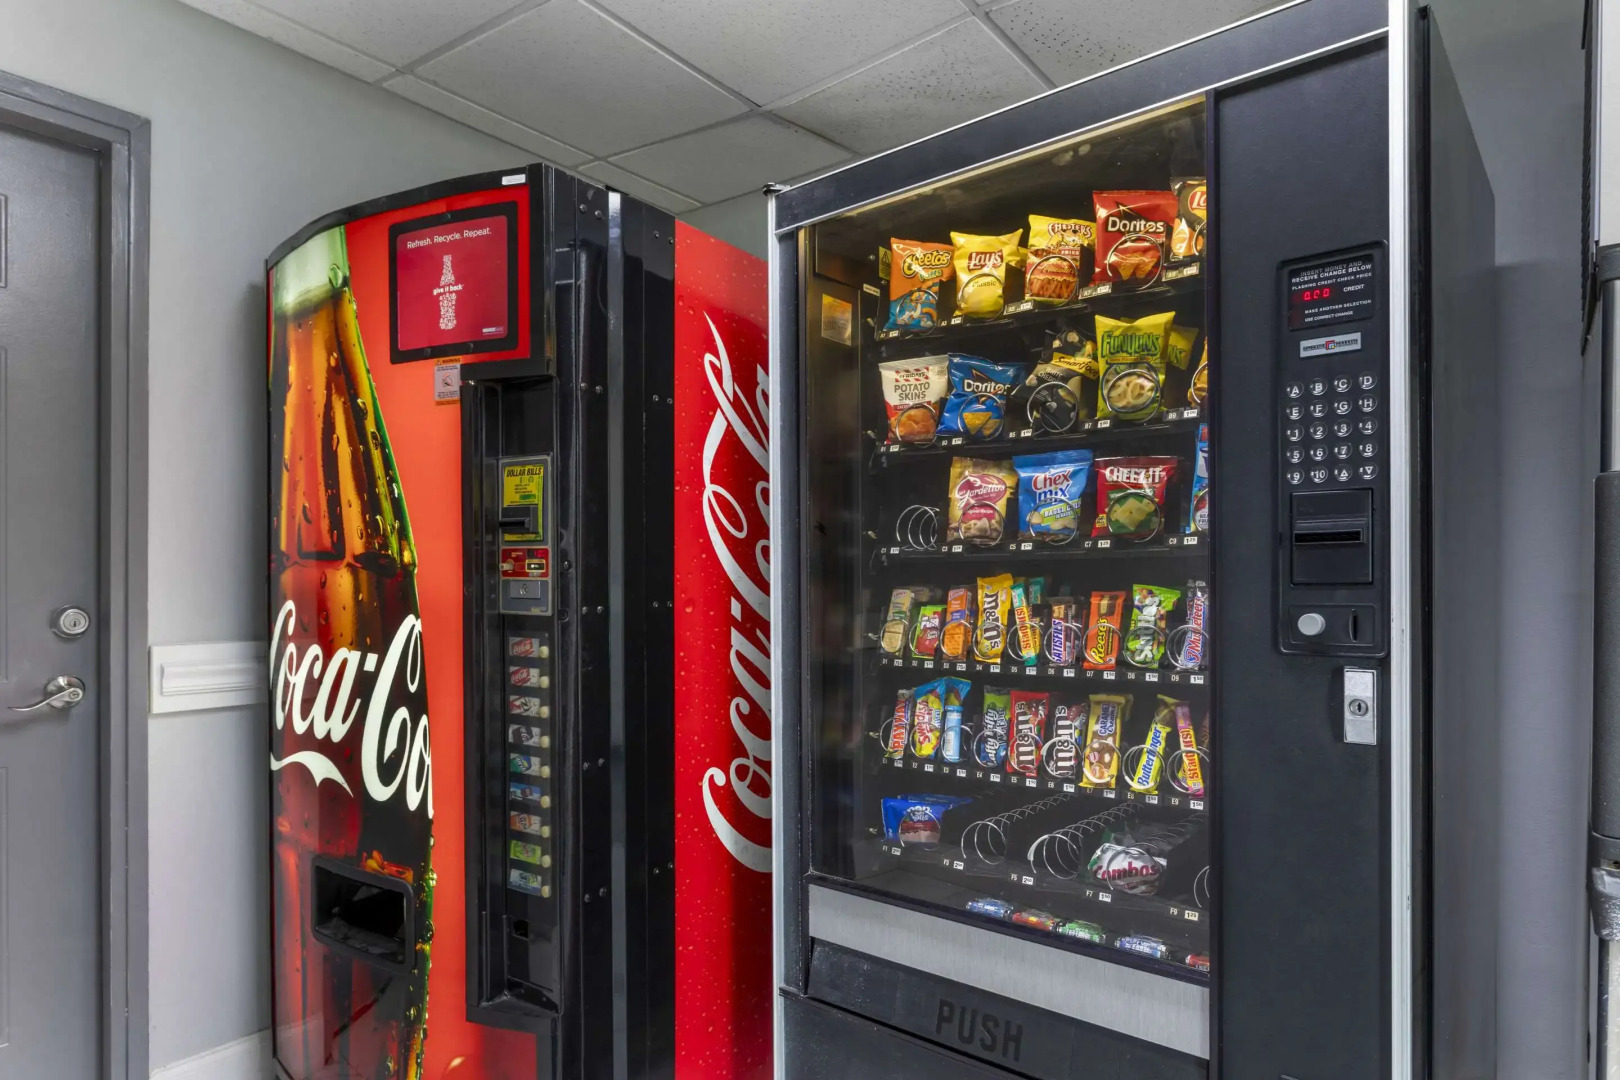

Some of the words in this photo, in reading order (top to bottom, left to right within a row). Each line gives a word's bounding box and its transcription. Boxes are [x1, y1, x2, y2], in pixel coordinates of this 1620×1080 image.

[1107, 216, 1165, 232] Doritos
[1047, 222, 1093, 238] CHESTER'S
[407, 238, 432, 249] Refresh.
[433, 232, 462, 243] Recycle.
[463, 227, 492, 238] Repeat.
[969, 251, 1003, 271] Lay's
[1300, 268, 1323, 276] INSERT
[1324, 264, 1347, 272] MONEY
[1348, 260, 1362, 268] AND
[1292, 274, 1318, 283] RECEIVE
[1320, 268, 1346, 278] CHANGE
[1348, 264, 1372, 272] BELOW
[1292, 282, 1316, 290] FLASHING
[1343, 284, 1365, 292] CREDIT
[433, 287, 444, 296] give
[1319, 304, 1342, 312] ANOTHER
[1344, 300, 1372, 308] SELECTION
[1101, 331, 1160, 358] FUNYUNS
[1339, 379, 1347, 388] C
[1363, 376, 1372, 384] D
[894, 381, 930, 393] POTATO
[1292, 386, 1299, 394] A
[1315, 383, 1322, 392] B
[898, 390, 926, 401] SKINS
[1340, 402, 1348, 410] G
[1364, 398, 1372, 408] H
[1292, 408, 1299, 416] E
[1316, 404, 1322, 413] F
[1340, 424, 1347, 432] 3
[1365, 421, 1372, 429] 4
[1294, 429, 1298, 438] 1
[1316, 426, 1322, 435] 2
[1316, 448, 1323, 456] 6
[1340, 446, 1347, 454] 7
[1366, 444, 1372, 452] 8
[1294, 451, 1300, 459] 5
[506, 468, 526, 478] DOLLAR
[527, 467, 542, 476] BILLS
[1315, 470, 1325, 478] 10
[1032, 470, 1072, 491] Chex
[1037, 484, 1070, 502] mix
[1090, 617, 1108, 664] Reese's
[935, 998, 1023, 1063] PUSH
